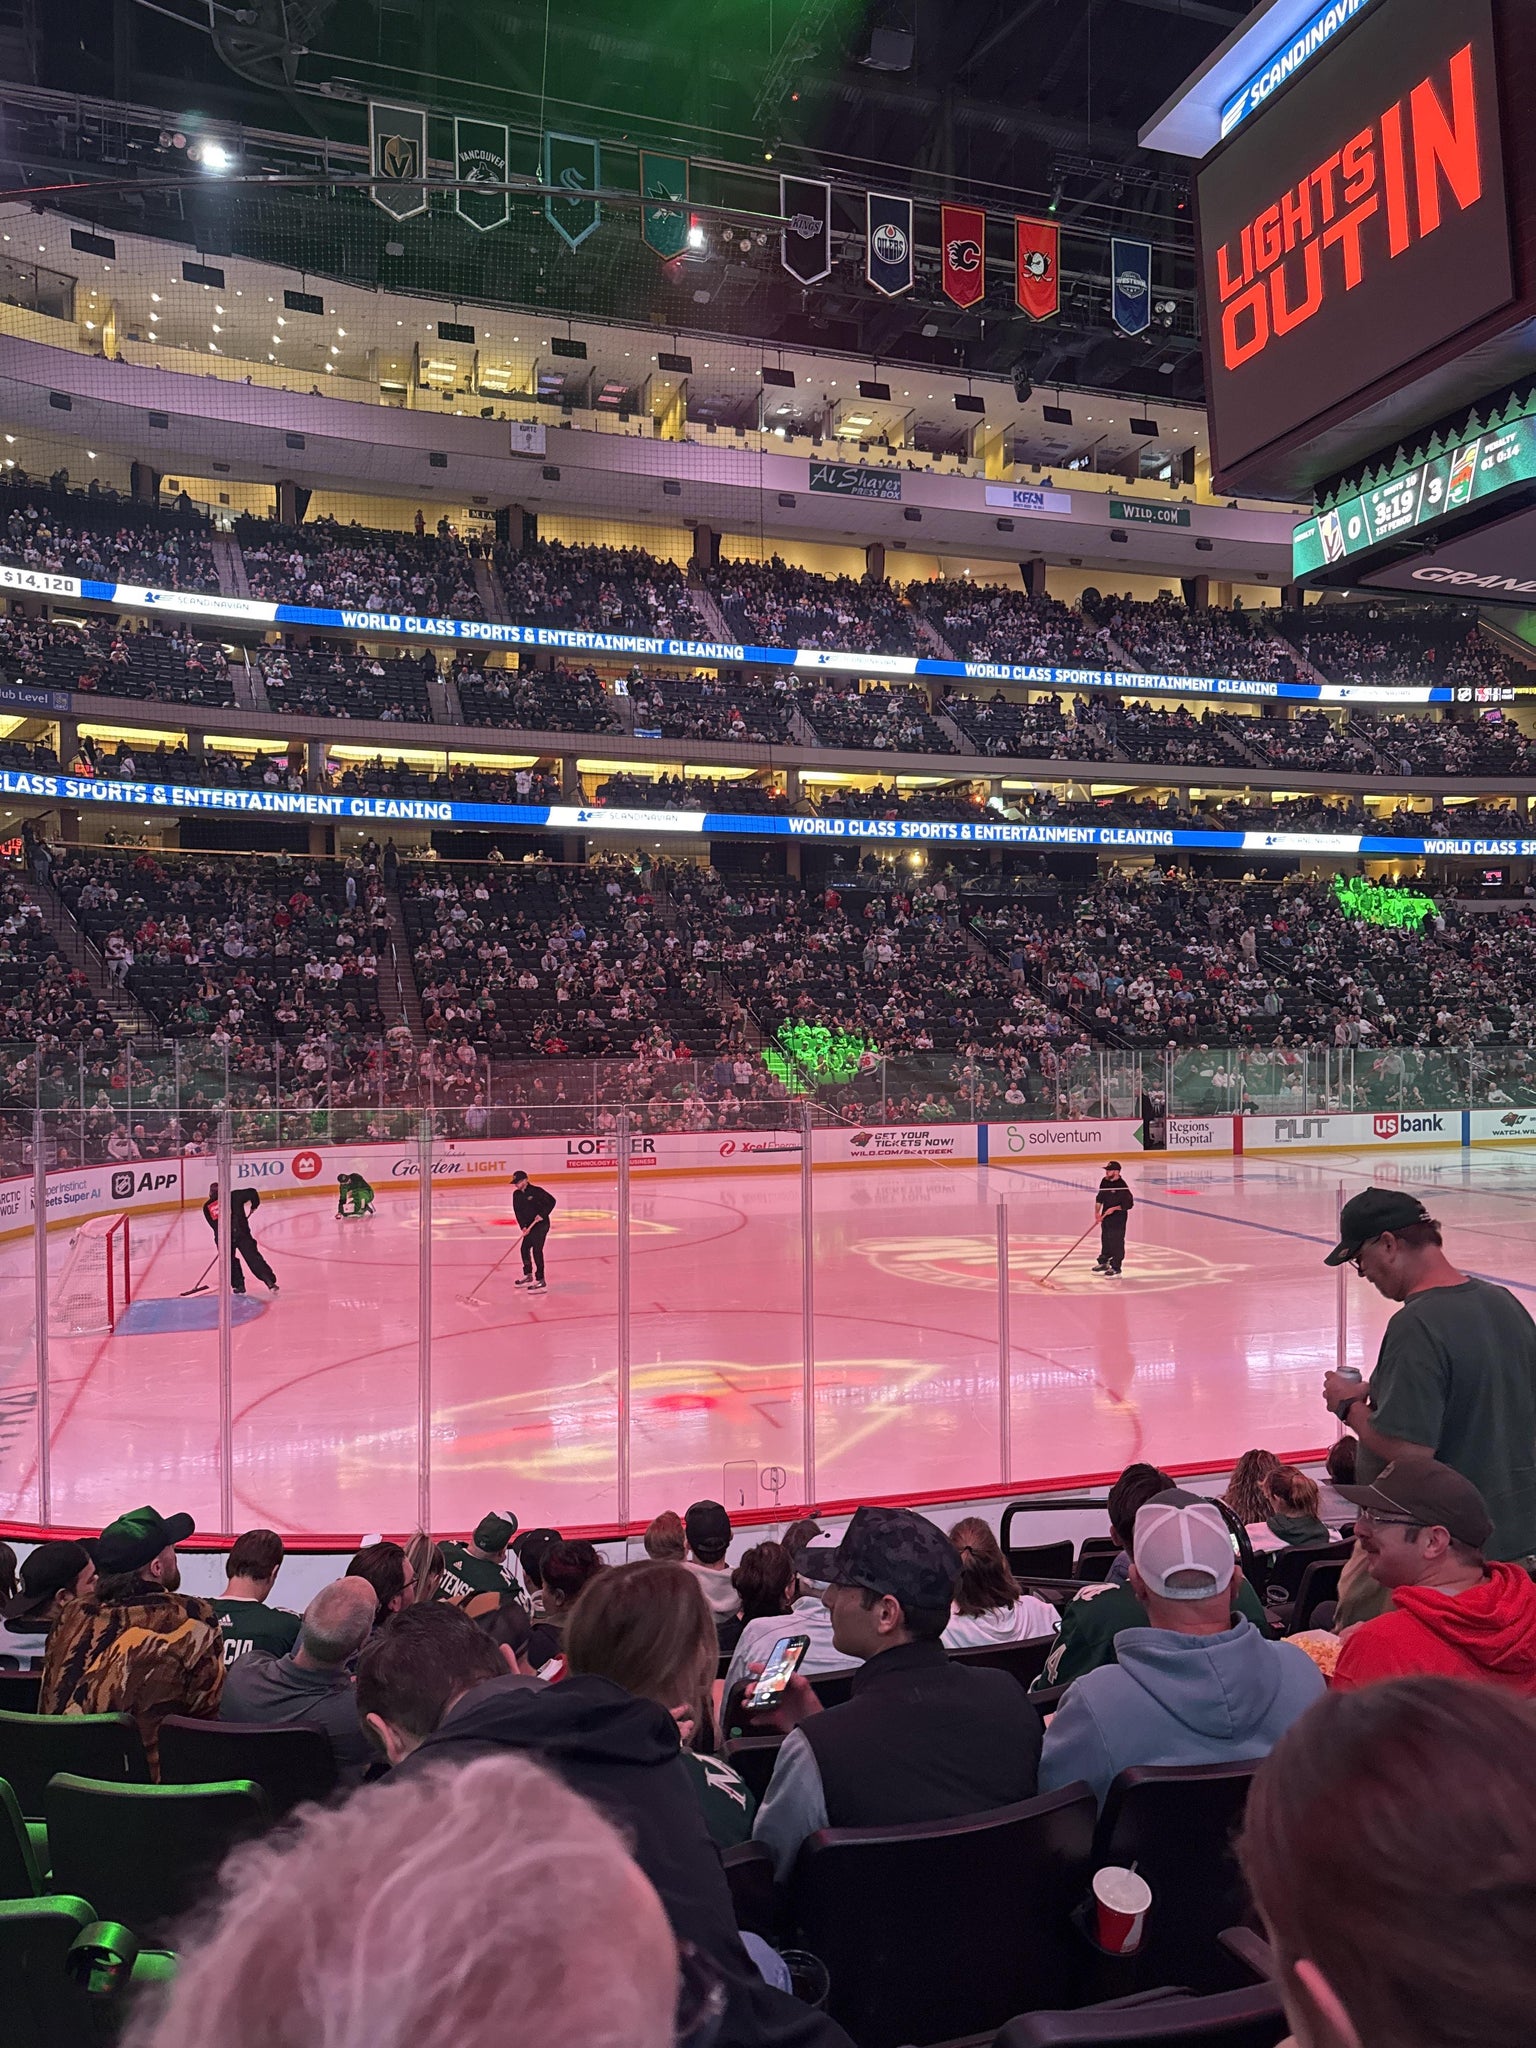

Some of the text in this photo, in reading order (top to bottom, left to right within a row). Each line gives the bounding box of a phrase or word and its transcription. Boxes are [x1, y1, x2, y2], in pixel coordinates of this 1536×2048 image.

[1250, 0, 1370, 107] SCANDINAVI
[1381, 41, 1481, 259] IN
[459, 150, 505, 169] VANCOUVER
[1217, 127, 1375, 303] LIGHTS
[793, 220, 821, 231] KINGS
[1222, 193, 1378, 371] OUT
[811, 465, 900, 490] Al Shaver
[851, 487, 900, 499] PRESS BOX
[1013, 491, 1044, 505] KFAN
[1427, 478, 1442, 504] 3
[1374, 489, 1414, 525] 3:19
[1348, 515, 1361, 540] 0
[340, 611, 745, 660] WORLD CLASS SPORTS & ENTERTAINMENT CLEANING
[964, 663, 1278, 696] WORLD CLASS SPORTS & ENTERTAINMENT CLEANING
[18, 691, 48, 704] Level
[0, 773, 453, 820] LASS SPORTS & ENTERTAINMENT CLEANING
[788, 818, 1174, 845] WORLD CLASS SPORTS & ENTERTAINMENT CLEANING
[1423, 840, 1472, 854] WORLD
[1473, 841, 1517, 855] CLASS
[1168, 1121, 1210, 1133] Regions
[1375, 1113, 1443, 1134] us bank
[874, 1131, 930, 1140] GET YOUR
[925, 1138, 954, 1146] NOW!
[1028, 1129, 1101, 1144] solventum
[1168, 1132, 1212, 1146] Hospital
[567, 1138, 655, 1155] LOFFER
[238, 1161, 285, 1178] BMO
[467, 1161, 507, 1173] LIGHT
[59, 1180, 87, 1191] Instinct
[64, 1191, 89, 1205] Super
[1047, 1643, 1067, 1685] 4
